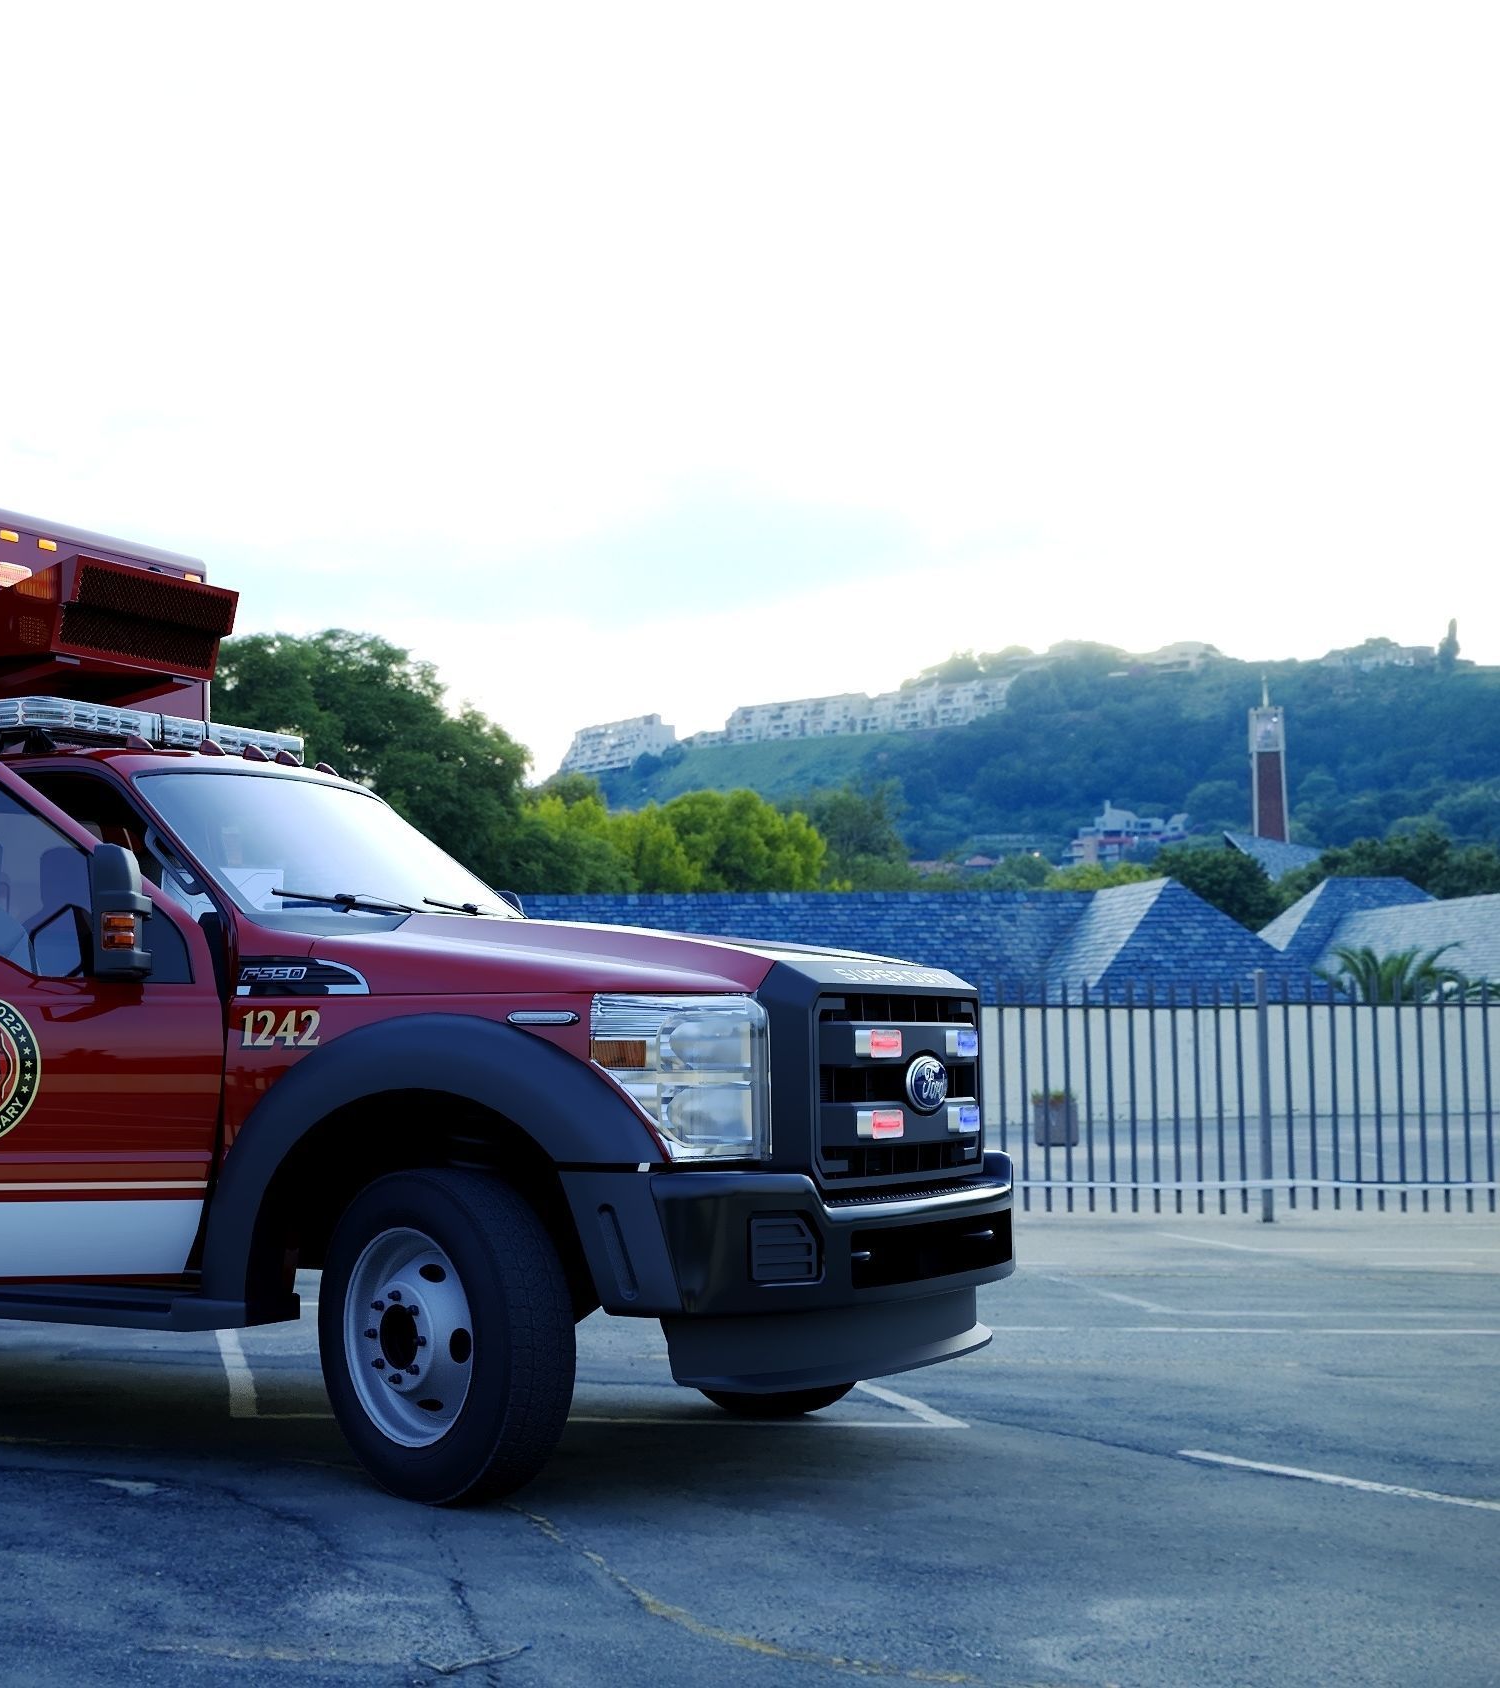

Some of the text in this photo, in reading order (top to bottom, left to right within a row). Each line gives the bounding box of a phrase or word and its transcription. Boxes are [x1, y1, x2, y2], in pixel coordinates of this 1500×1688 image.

[833, 968, 906, 983] SUPER
[241, 1009, 321, 1047] 1242
[922, 1061, 946, 1101] Ford
